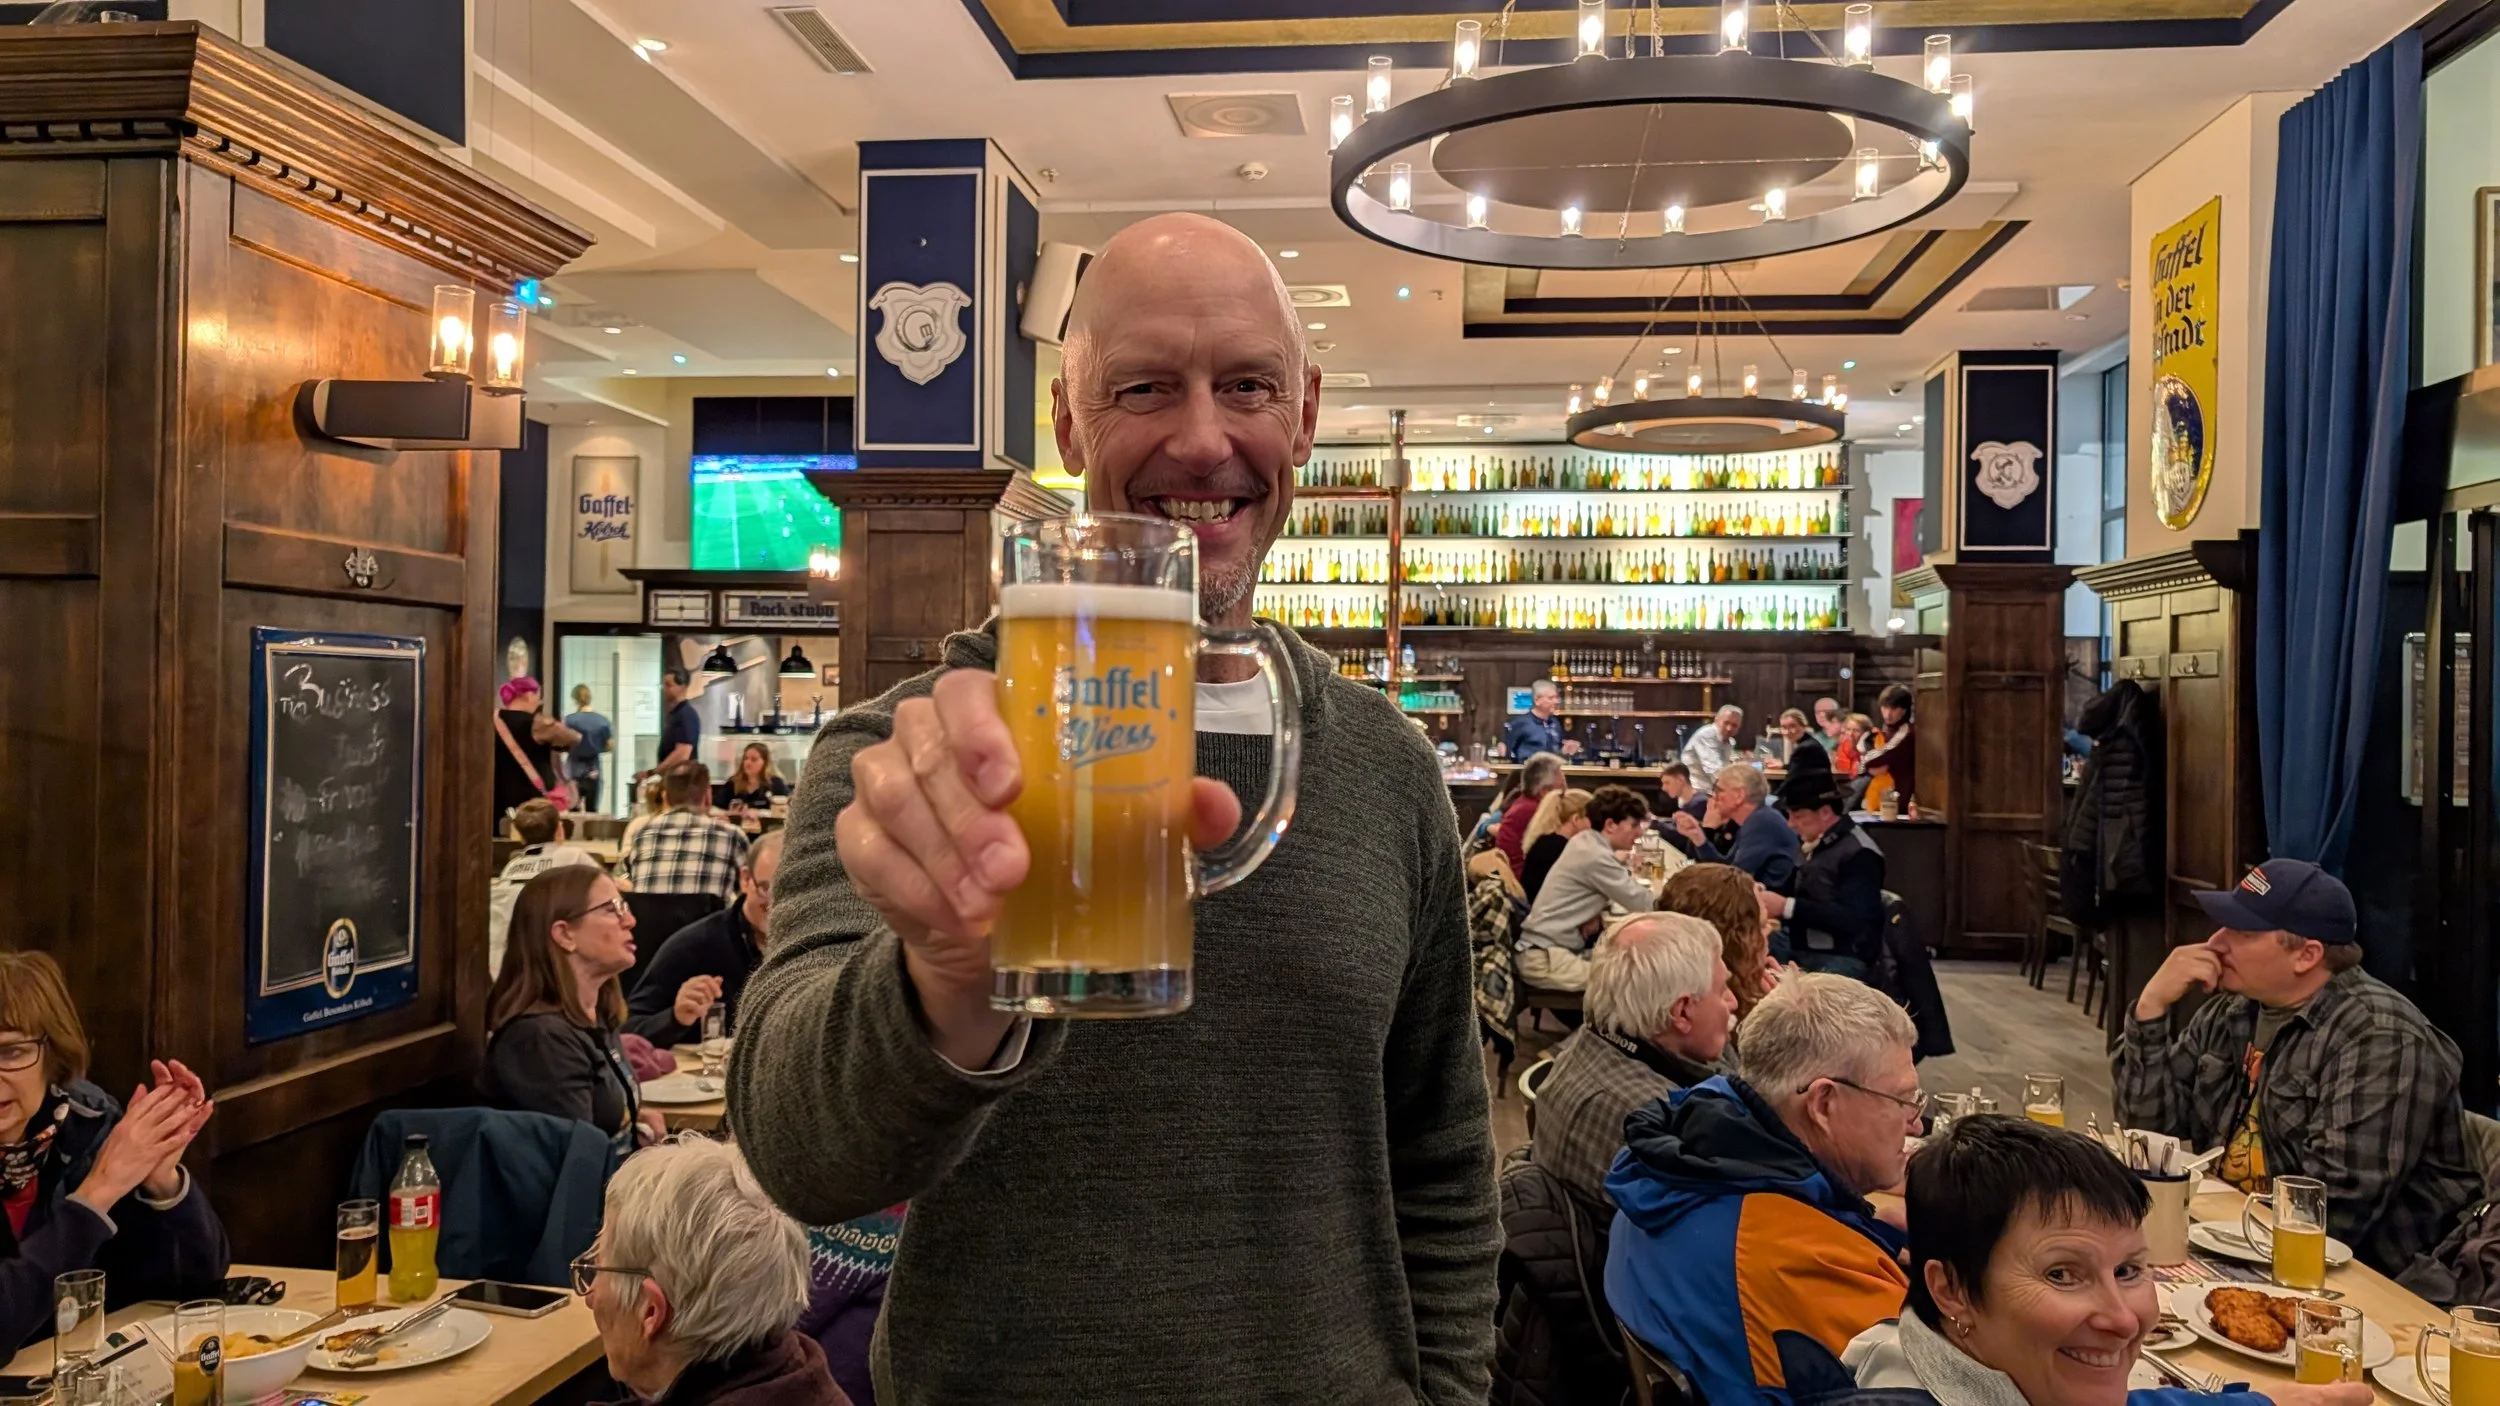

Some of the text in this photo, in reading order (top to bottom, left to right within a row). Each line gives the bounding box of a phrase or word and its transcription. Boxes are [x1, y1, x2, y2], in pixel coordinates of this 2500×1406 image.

[2153, 221, 2207, 288] Gaffel
[2166, 283, 2195, 318] der
[1056, 665, 1160, 710] Gaffel
